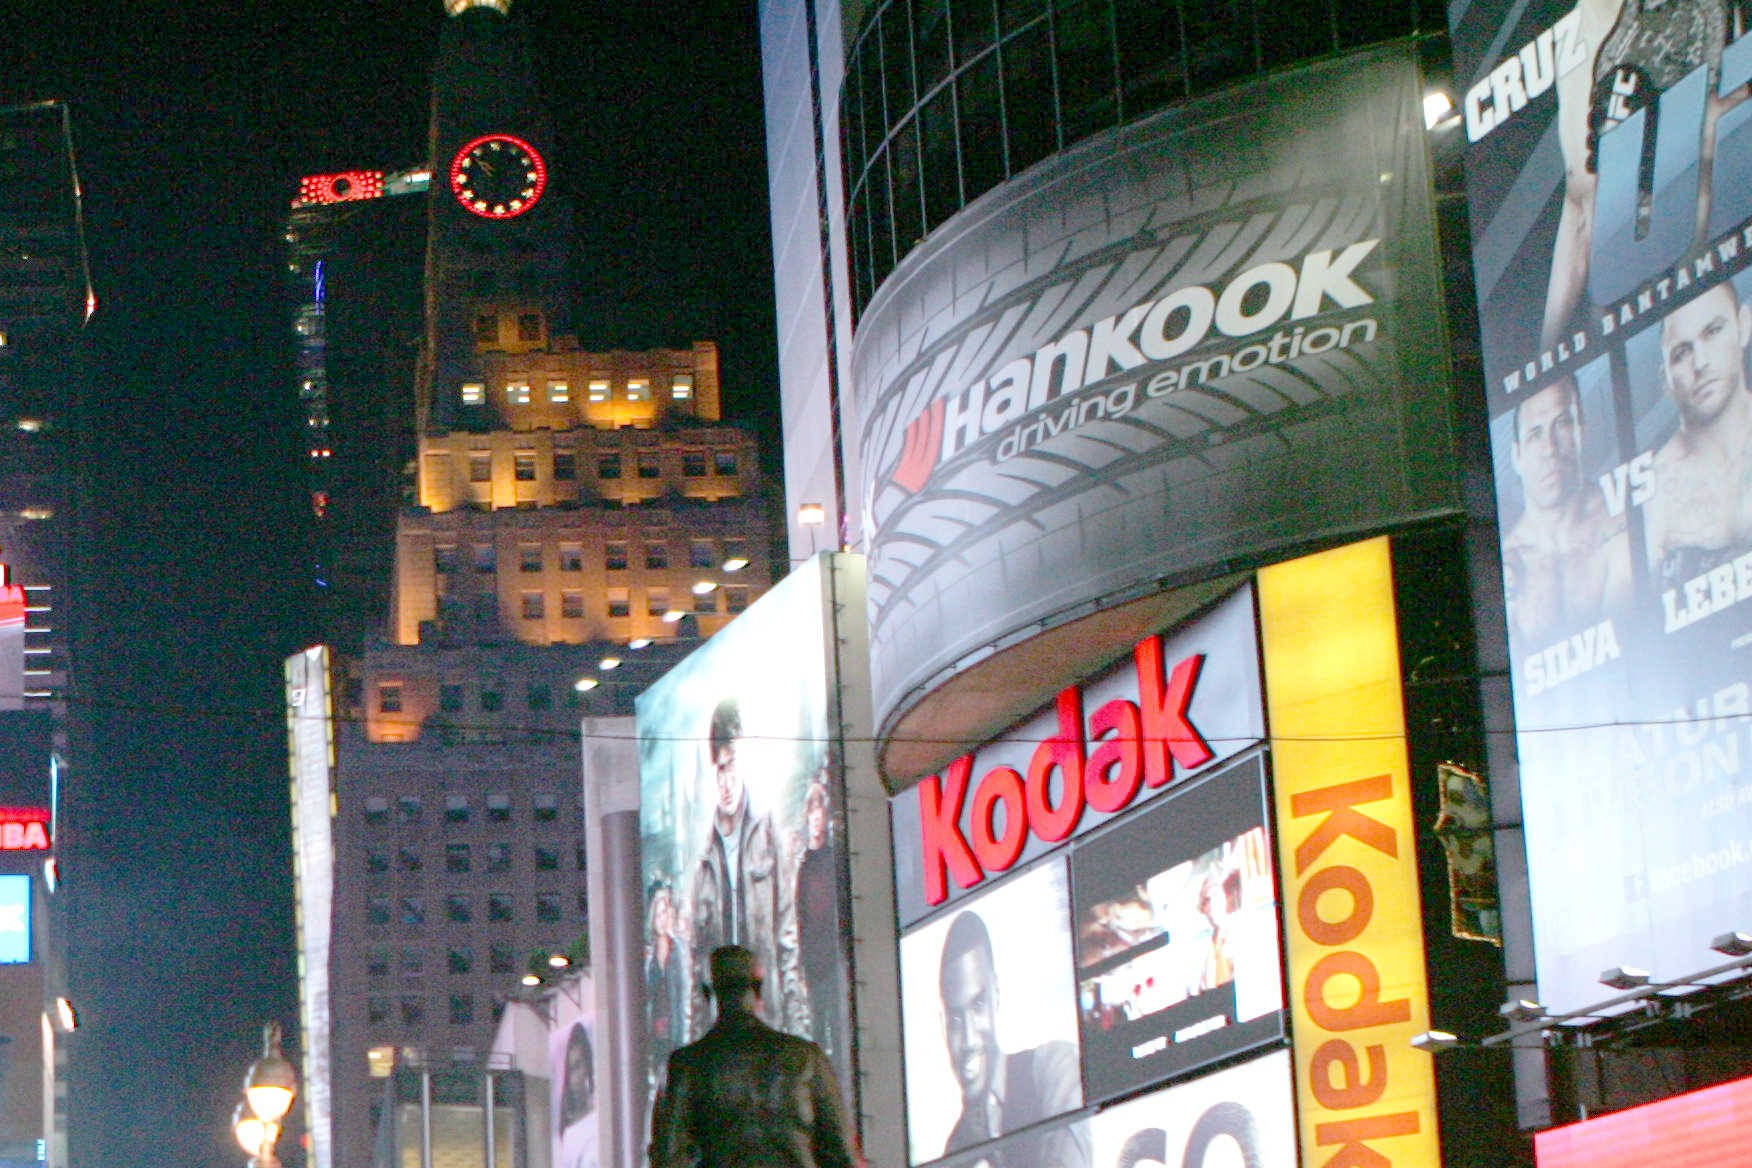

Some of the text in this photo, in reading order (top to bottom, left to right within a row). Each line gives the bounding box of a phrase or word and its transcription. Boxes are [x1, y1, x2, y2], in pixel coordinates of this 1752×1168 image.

[1464, 8, 1588, 143] CRUZ
[996, 317, 1377, 466] driving emotion
[1503, 331, 1587, 395] WORLD
[1599, 450, 1657, 518] VS
[1521, 618, 1622, 698] SILVA
[917, 633, 1216, 908] Kodak
